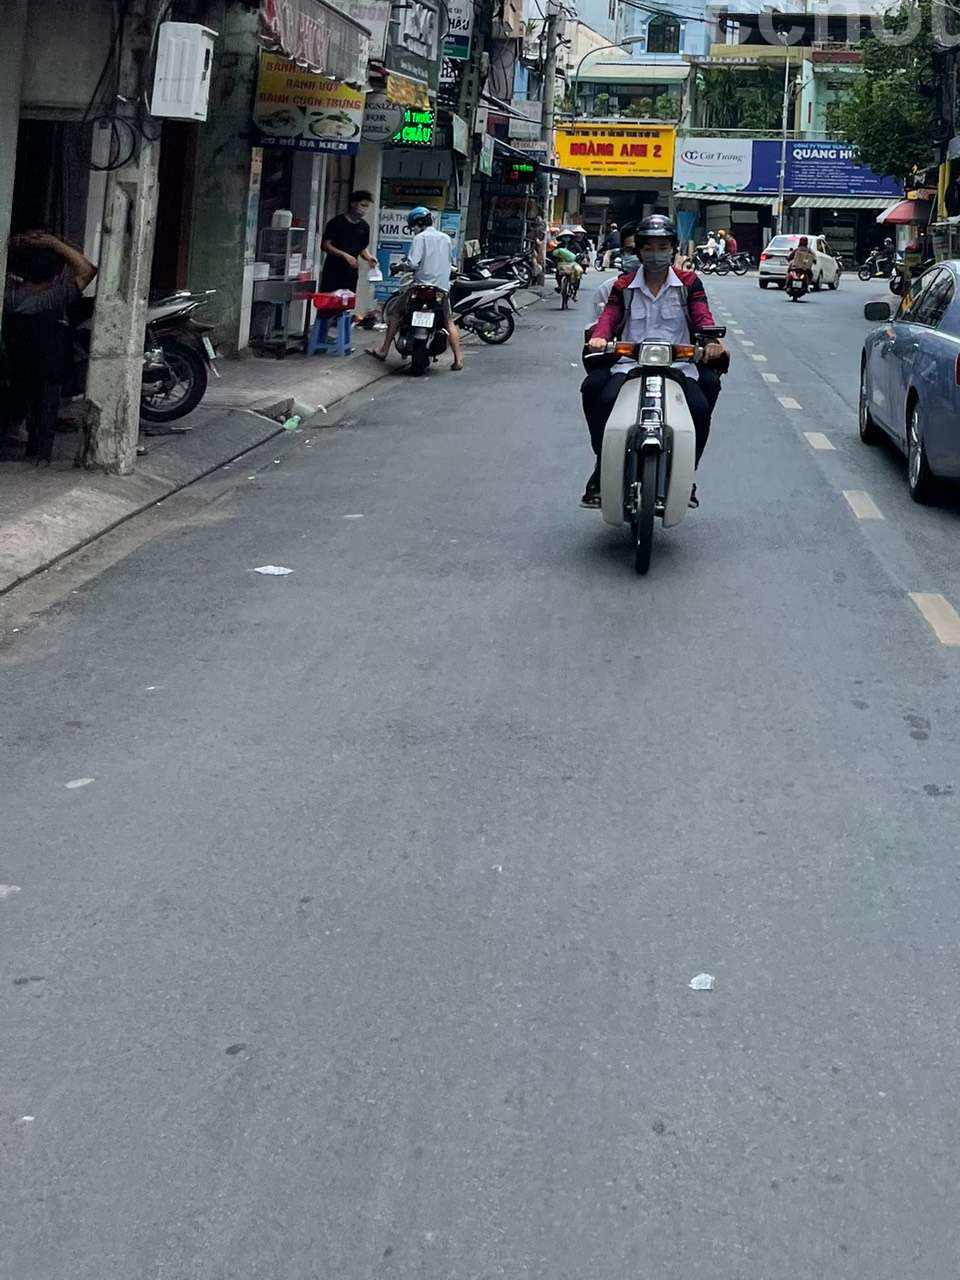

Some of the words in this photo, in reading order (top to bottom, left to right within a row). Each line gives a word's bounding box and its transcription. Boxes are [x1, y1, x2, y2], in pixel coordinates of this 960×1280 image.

[448, 16, 471, 31] HÂU
[569, 140, 614, 157] HOÀNG
[619, 142, 649, 158] ANH
[652, 144, 662, 158] 2
[792, 148, 837, 160] QUANG
[379, 224, 400, 235] KIM
